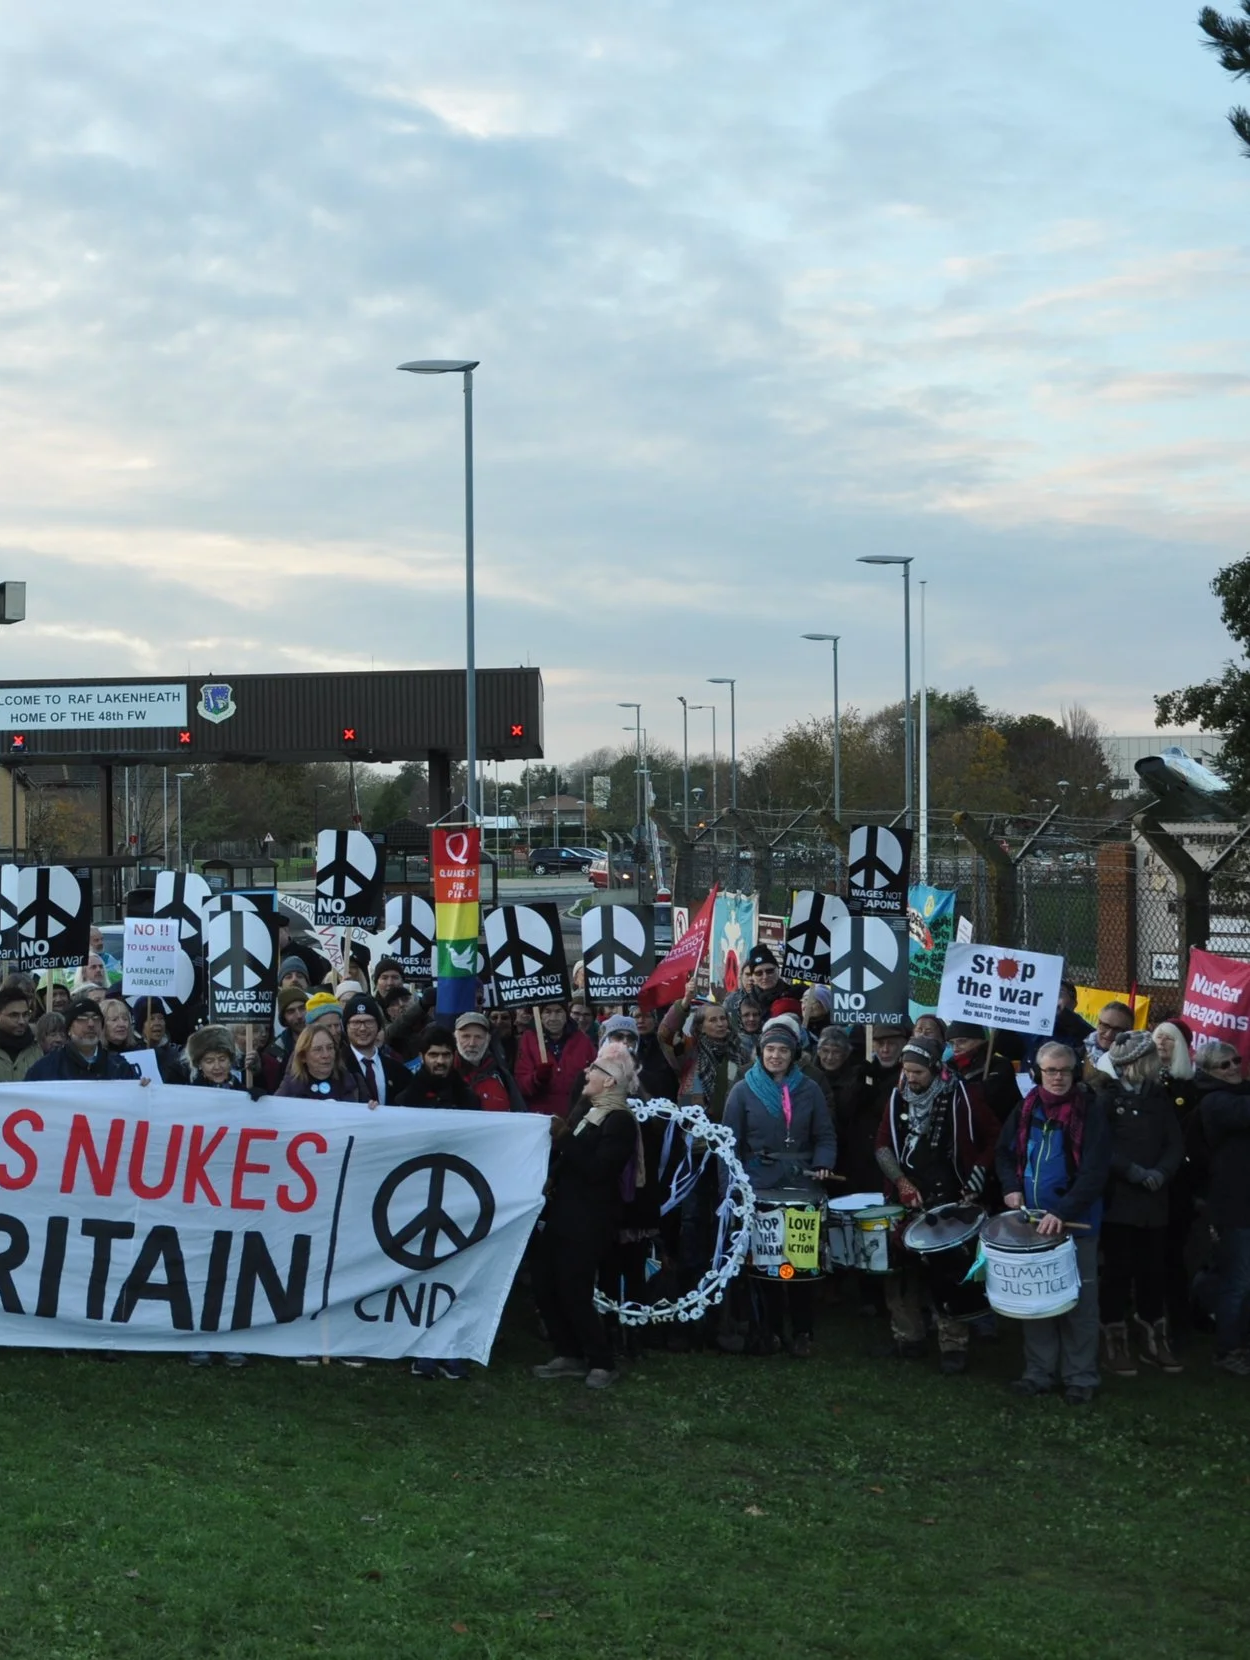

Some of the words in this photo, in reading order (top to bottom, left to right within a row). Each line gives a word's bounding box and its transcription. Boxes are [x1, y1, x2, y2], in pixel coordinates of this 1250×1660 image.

[45, 694, 61, 705] TO
[68, 693, 92, 705] RAF
[96, 691, 181, 704] LAKENHEATH
[10, 712, 47, 724] HOME
[50, 712, 67, 723] OF
[72, 711, 95, 722] THE
[98, 710, 124, 721] 48th
[127, 709, 148, 721] FW
[445, 832, 469, 865] Q
[439, 868, 477, 879] QUAKERS
[850, 888, 885, 899] WAGES
[885, 891, 904, 901] NOT
[280, 895, 316, 921] ALWAY
[317, 897, 347, 914] NO
[863, 898, 902, 911] APONS
[316, 914, 356, 926] nuclear
[357, 915, 378, 926] war
[134, 923, 155, 936] NO
[20, 939, 50, 959] NO
[127, 943, 138, 952] TO
[138, 943, 149, 952] US
[150, 944, 176, 953] NUKES
[20, 956, 60, 972] nuclear
[62, 954, 85, 968] war
[146, 955, 155, 963] AT
[784, 952, 815, 970] NO
[126, 966, 175, 976] LAKENHEATH
[403, 965, 433, 976] APONS
[783, 967, 827, 984] nuclear
[498, 976, 540, 990] WAGES
[541, 972, 564, 986] NOT
[588, 976, 628, 986] WAGES
[1190, 972, 1244, 1004] Nuclear
[214, 990, 258, 1001] WAGES
[258, 991, 274, 1001] NOT
[500, 984, 564, 1002] WEAPONS
[588, 986, 643, 998] WEAPON
[957, 975, 992, 999] the
[999, 985, 1044, 1007] war
[214, 1001, 273, 1014] WEAPONS
[833, 992, 867, 1011] NO
[965, 1000, 993, 1012] Russian
[994, 1004, 1017, 1017] troops
[1018, 1009, 1031, 1018] out
[833, 1010, 878, 1024] nuclear
[879, 1012, 904, 1025] war
[962, 1008, 973, 1017] No
[974, 1011, 993, 1022] NATO
[993, 1015, 1031, 1028] expansion
[1182, 999, 1250, 1032] weapons
[60, 1116, 330, 1214] NUKES
[754, 1217, 780, 1231] TOP
[788, 1216, 817, 1231] LOVE
[798, 1232, 807, 1242] IS
[756, 1243, 784, 1257] HARM
[993, 1261, 1061, 1279] CLIMATE
[1000, 1275, 1068, 1297] JUSTICE
[353, 1281, 456, 1328] CND
